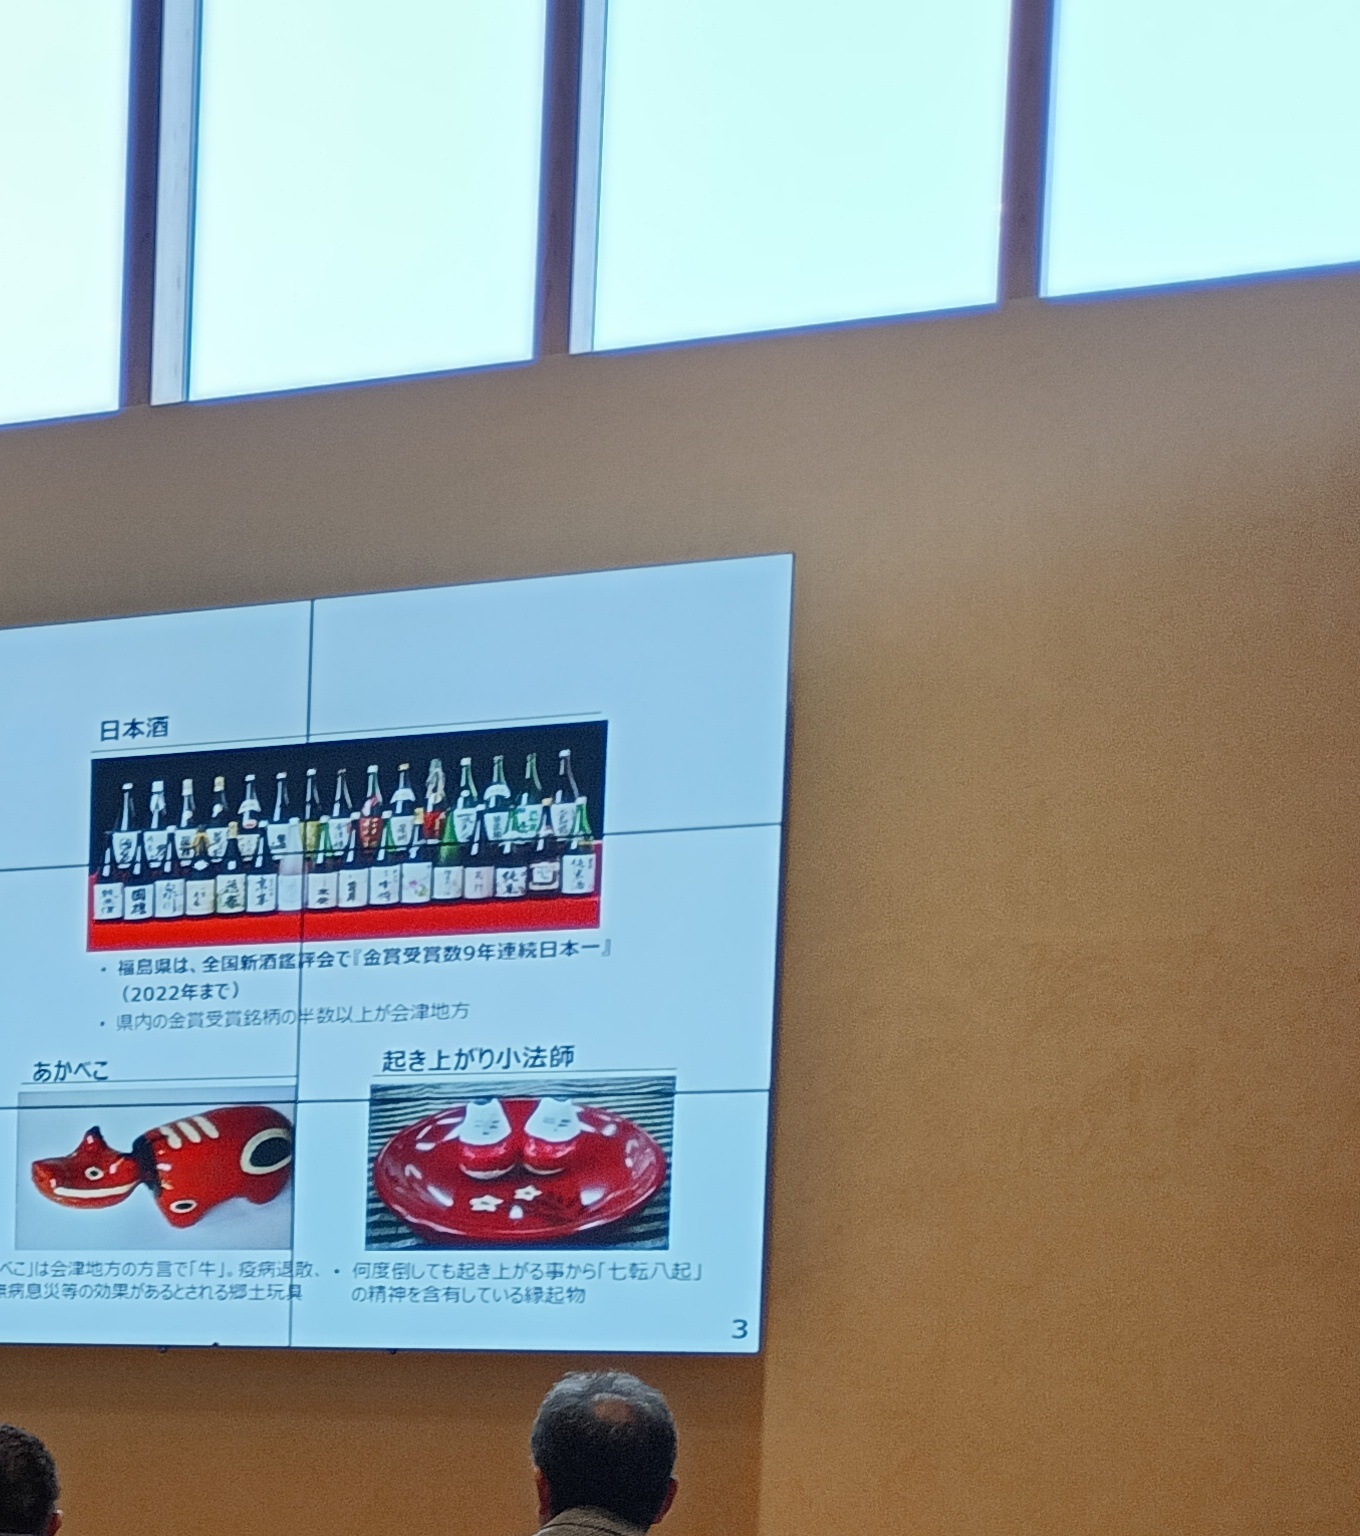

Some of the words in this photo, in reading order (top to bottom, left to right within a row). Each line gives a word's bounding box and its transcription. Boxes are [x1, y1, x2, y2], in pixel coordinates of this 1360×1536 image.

[100, 716, 170, 742] 日本酒
[116, 1001, 470, 1033] 県内の金賞受賞銘柄の半数以上が会津地方
[382, 1044, 576, 1073] 起き上がり小法師
[32, 1059, 109, 1083] あかべこ
[352, 1262, 704, 1282] 何度倒しても起き上がる事から「七転八起」
[352, 1286, 586, 1305] の精神を含有している縁起物
[731, 1319, 748, 1340] 3
